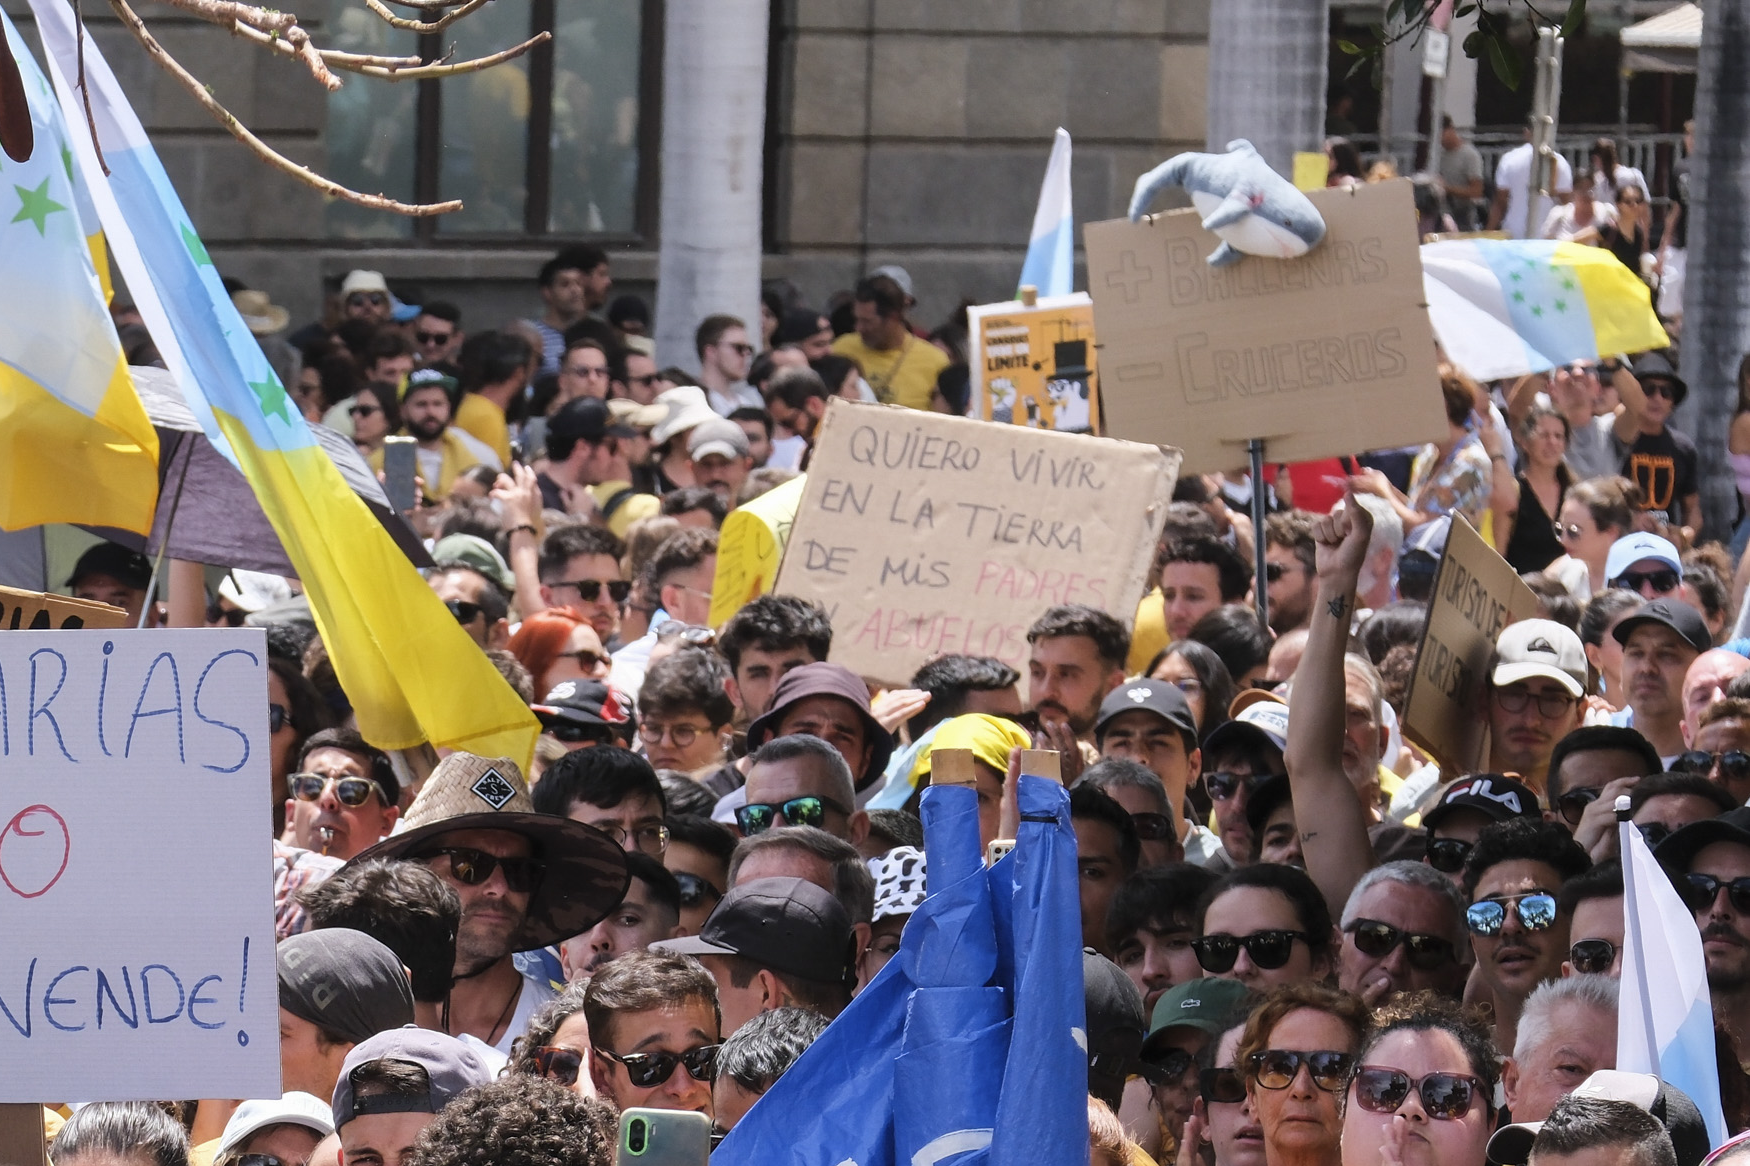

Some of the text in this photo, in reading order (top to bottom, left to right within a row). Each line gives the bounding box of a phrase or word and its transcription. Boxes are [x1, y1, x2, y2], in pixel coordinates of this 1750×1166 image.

[1174, 327, 1408, 405] CRUCEROS
[850, 425, 1107, 491] QUIERO VIVIR
[819, 479, 1083, 553] EN LA TIERRA
[804, 539, 1108, 609] DE MIS PADRES
[855, 607, 1030, 664] ABUELOS
[1446, 779, 1523, 813] FILA
